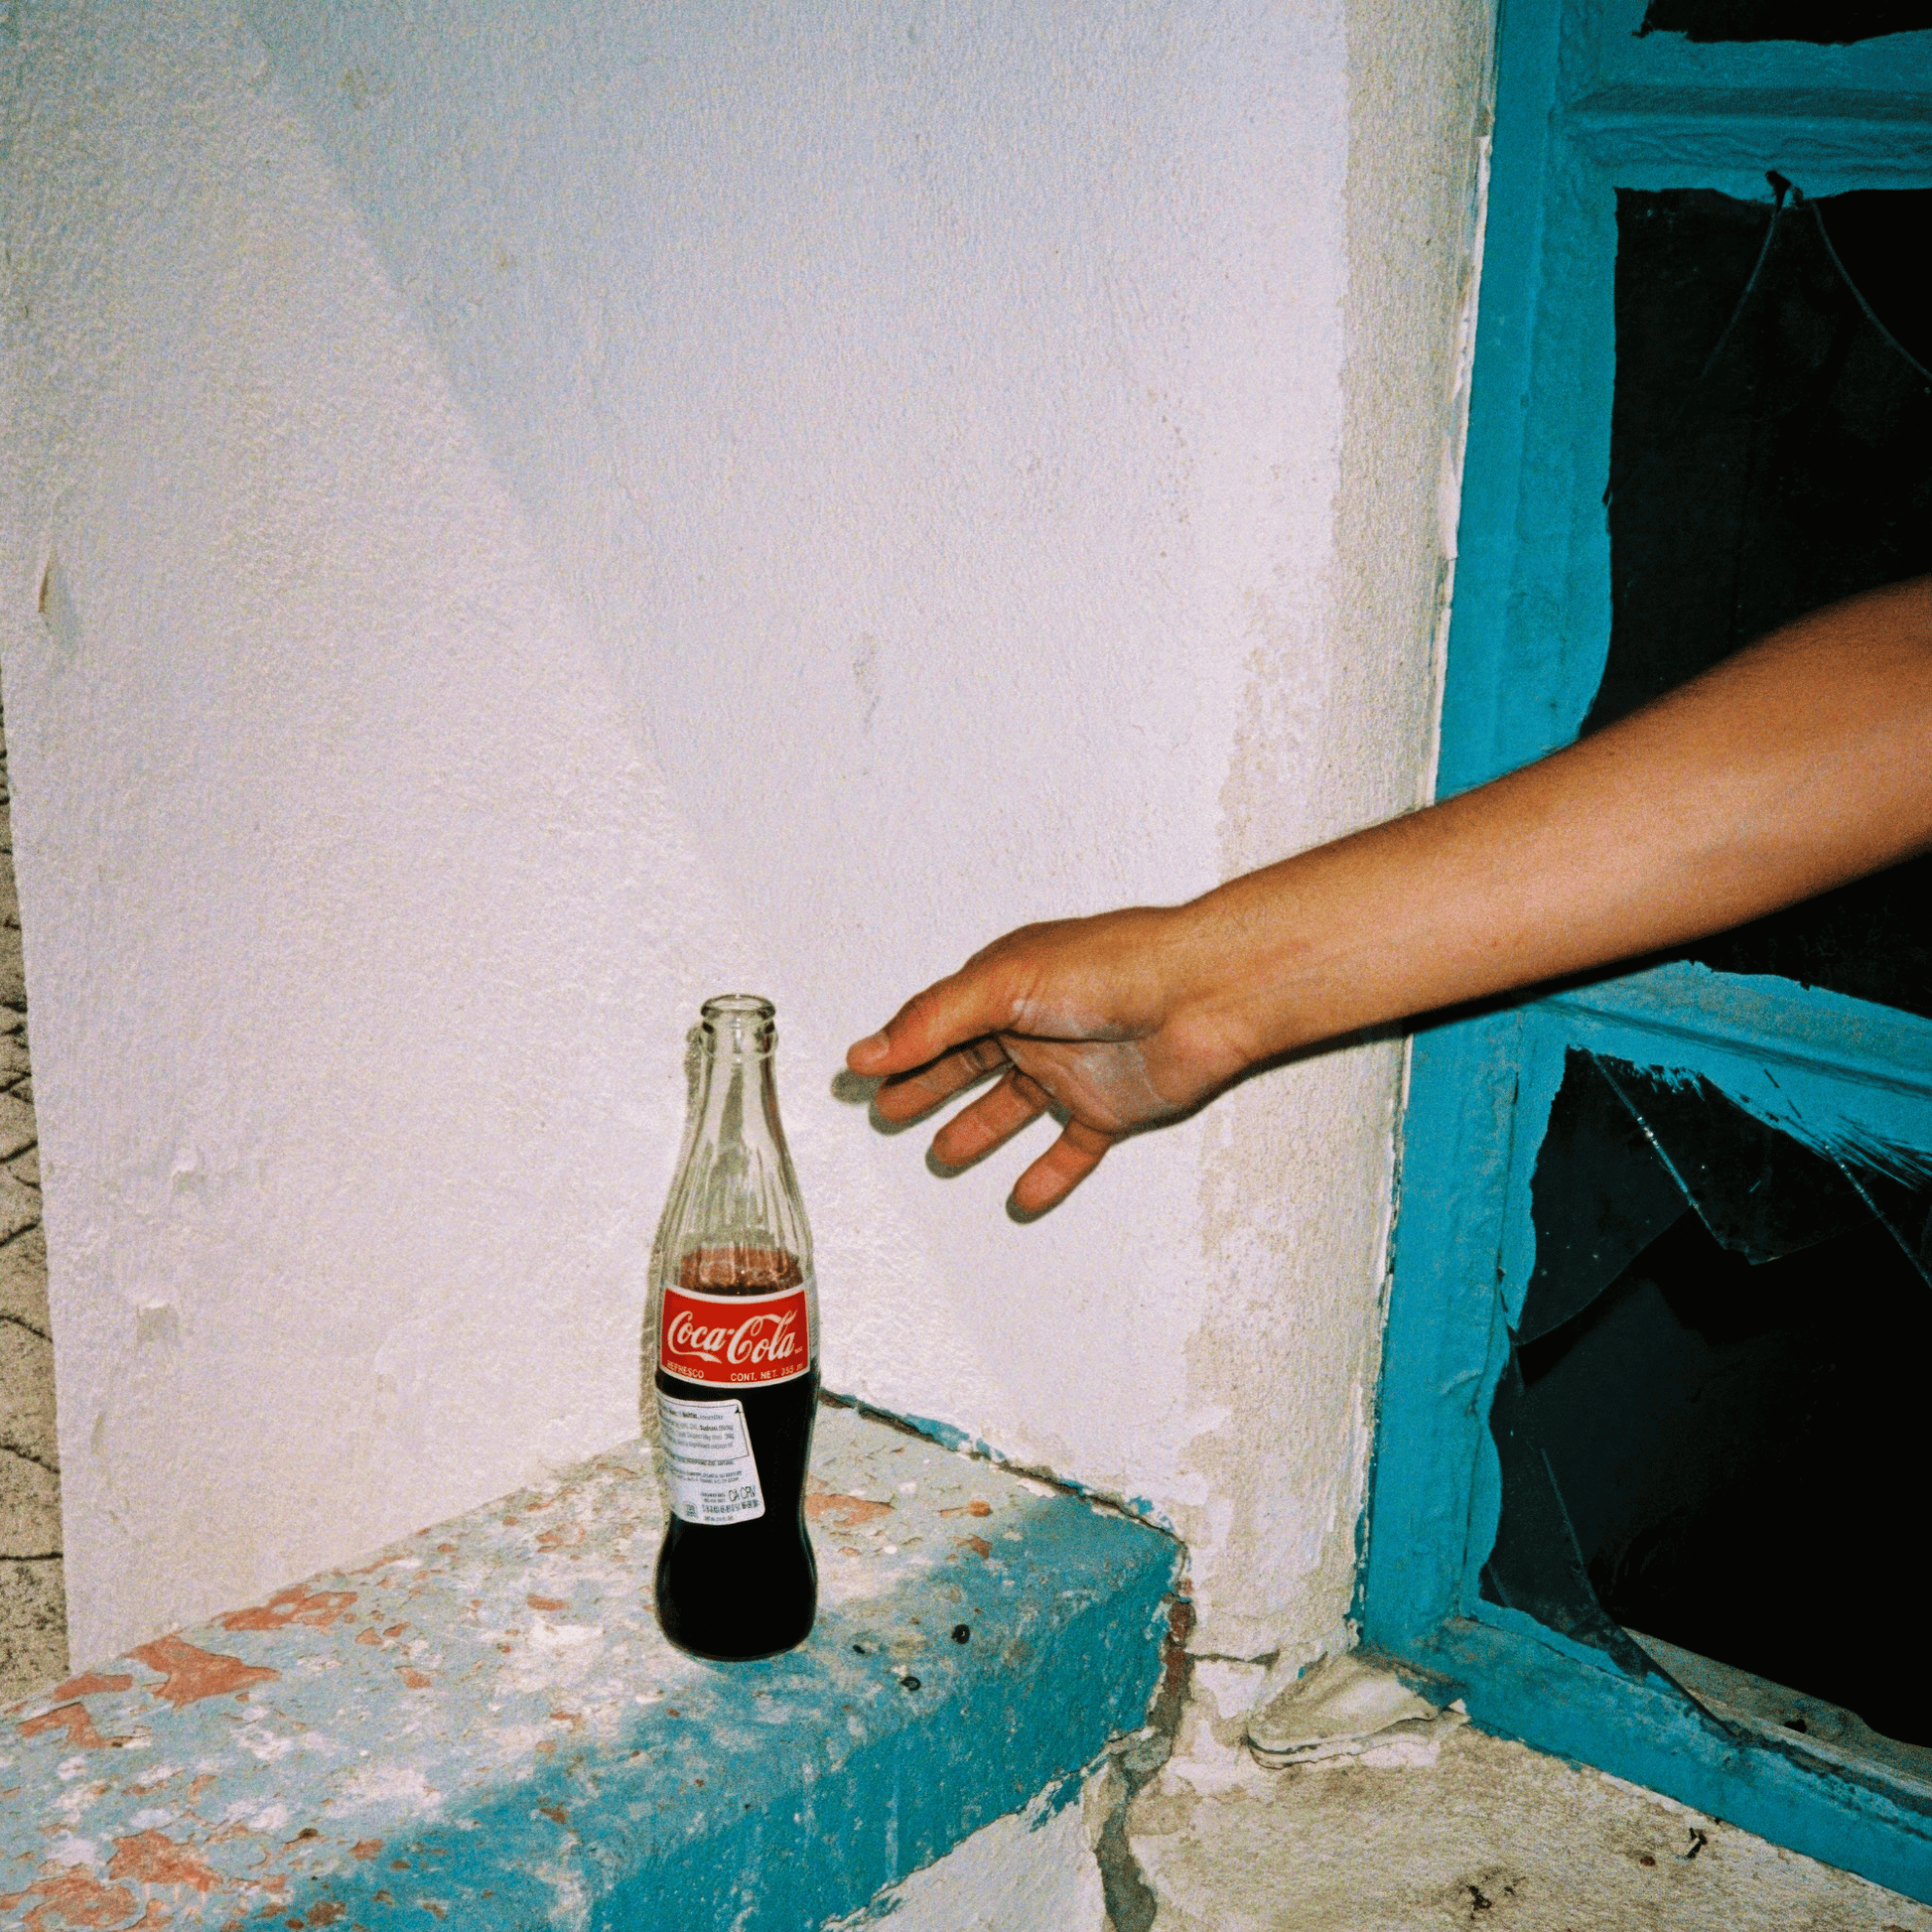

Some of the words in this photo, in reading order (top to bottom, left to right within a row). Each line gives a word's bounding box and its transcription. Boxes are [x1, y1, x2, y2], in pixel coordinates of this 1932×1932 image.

[667, 1310, 797, 1364] Coca-Cola
[731, 1373, 758, 1382] CONT.
[760, 1369, 778, 1380] NET.
